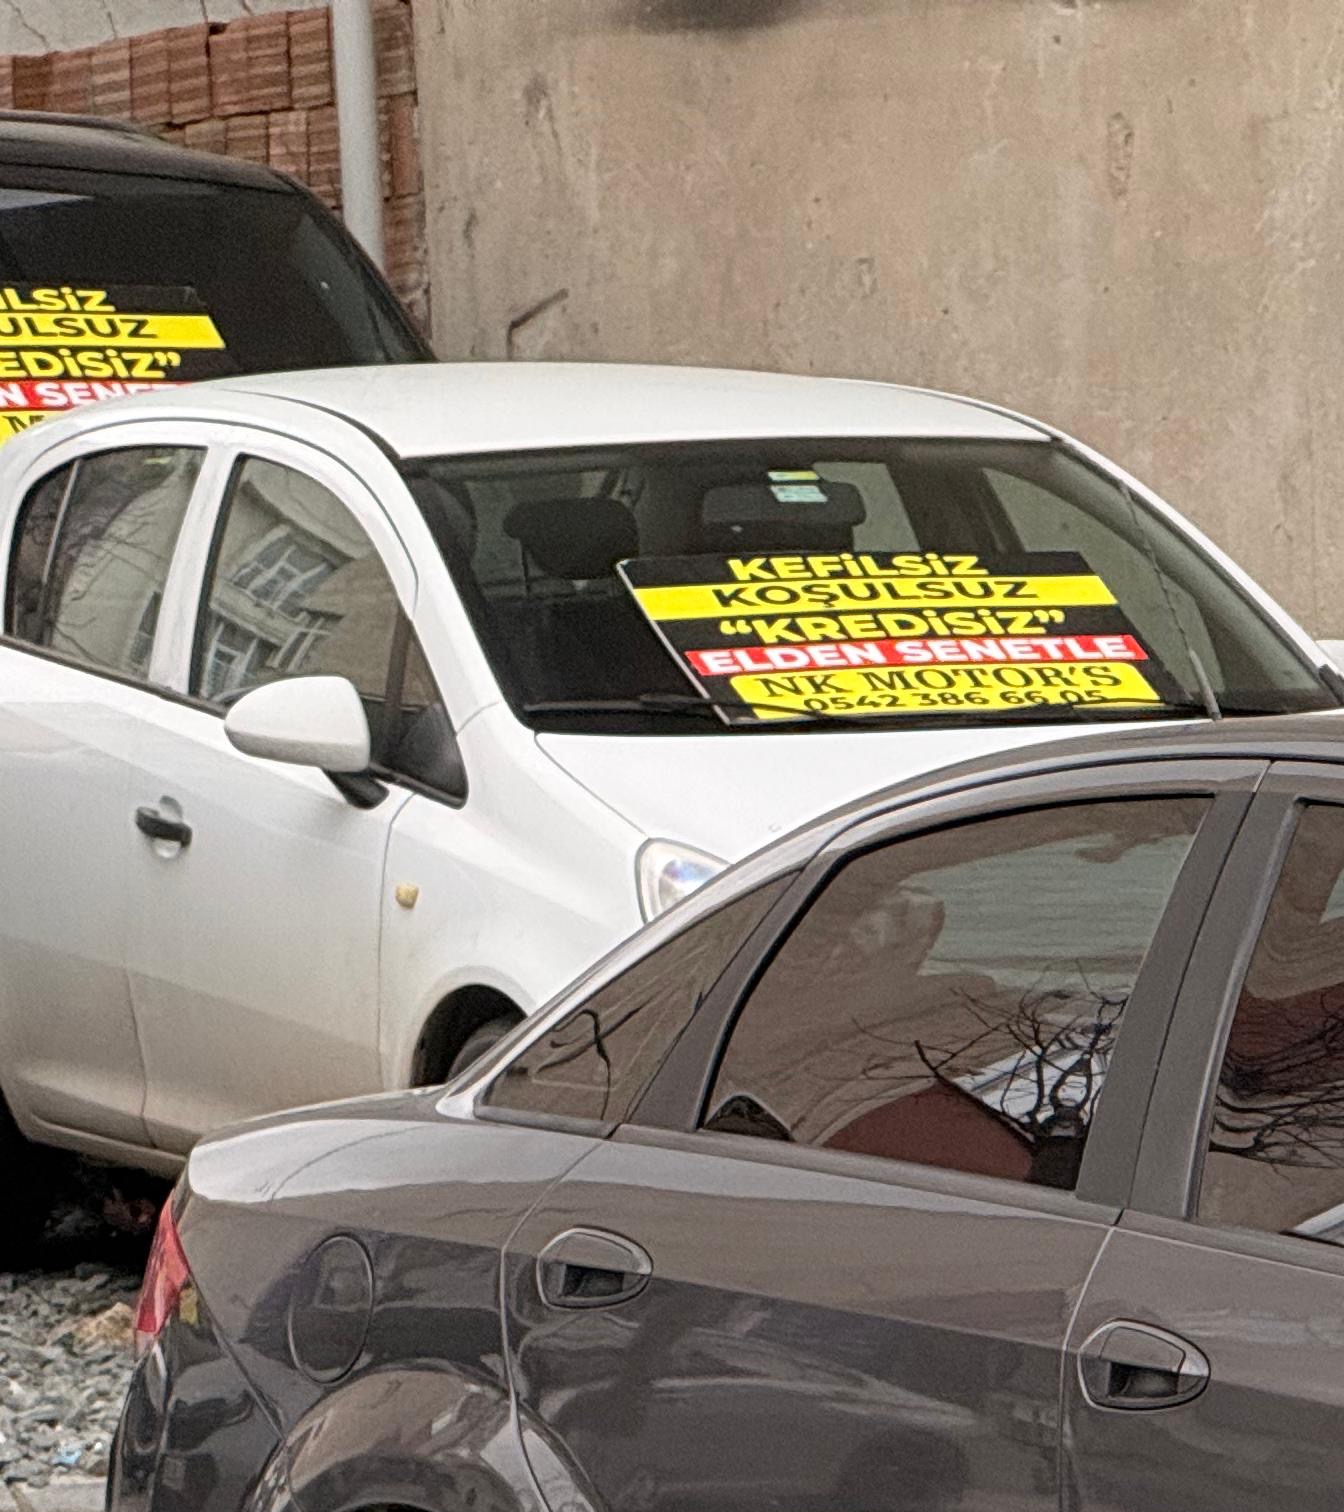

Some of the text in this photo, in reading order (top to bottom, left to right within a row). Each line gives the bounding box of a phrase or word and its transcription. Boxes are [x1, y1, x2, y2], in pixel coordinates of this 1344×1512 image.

[712, 581, 1039, 608] KOŞULSUZ
[700, 636, 1135, 673] ELDEN SENETLE
[756, 666, 1122, 698] NK MOTOR'S
[803, 694, 900, 712] 0542
[912, 691, 989, 706] 386
[1000, 690, 1050, 704] 66
